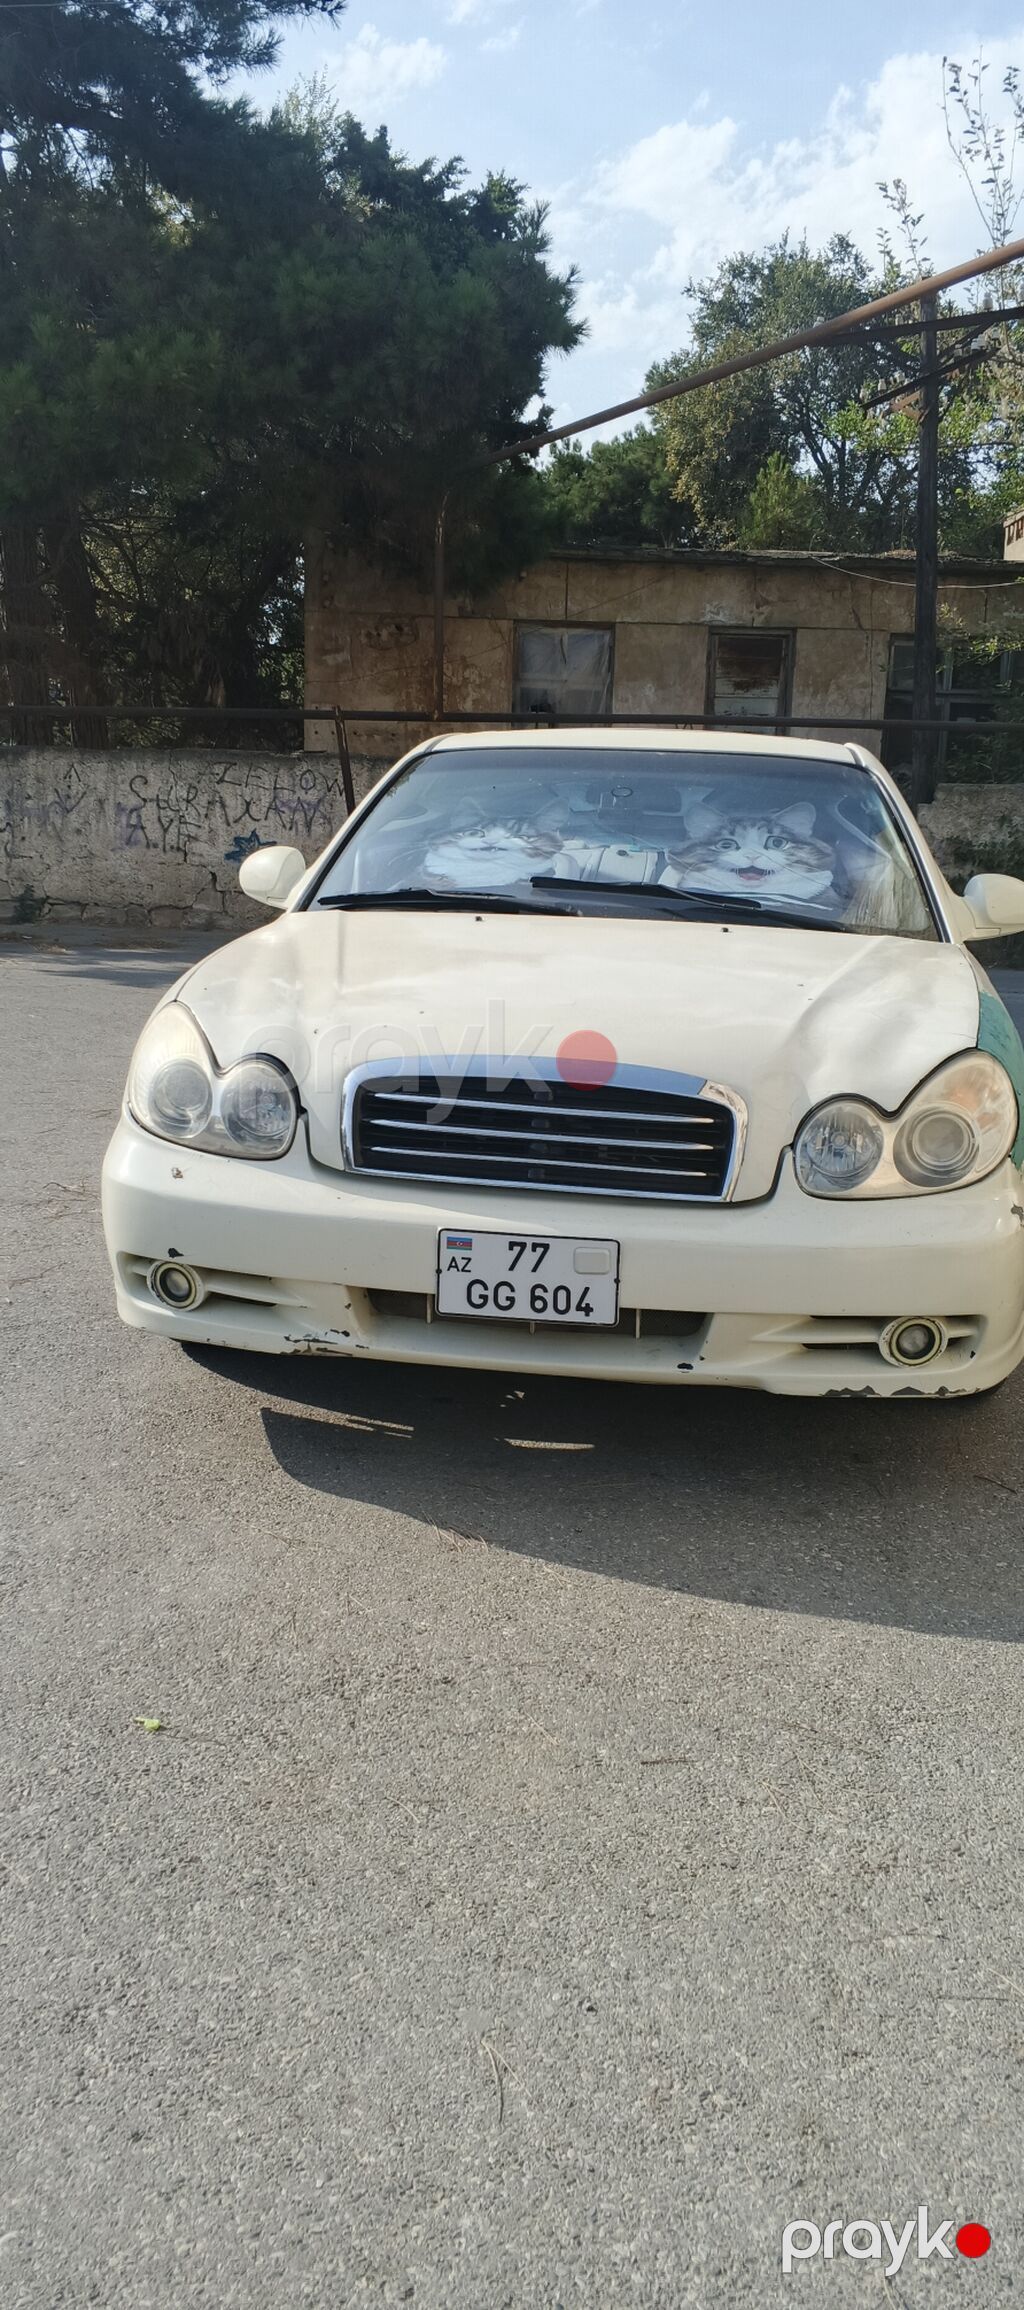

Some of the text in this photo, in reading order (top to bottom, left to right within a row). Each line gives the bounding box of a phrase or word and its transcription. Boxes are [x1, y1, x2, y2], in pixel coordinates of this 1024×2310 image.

[447, 1256, 472, 1273] AZ
[508, 1241, 550, 1273] 77
[466, 1279, 594, 1317] GG 604
